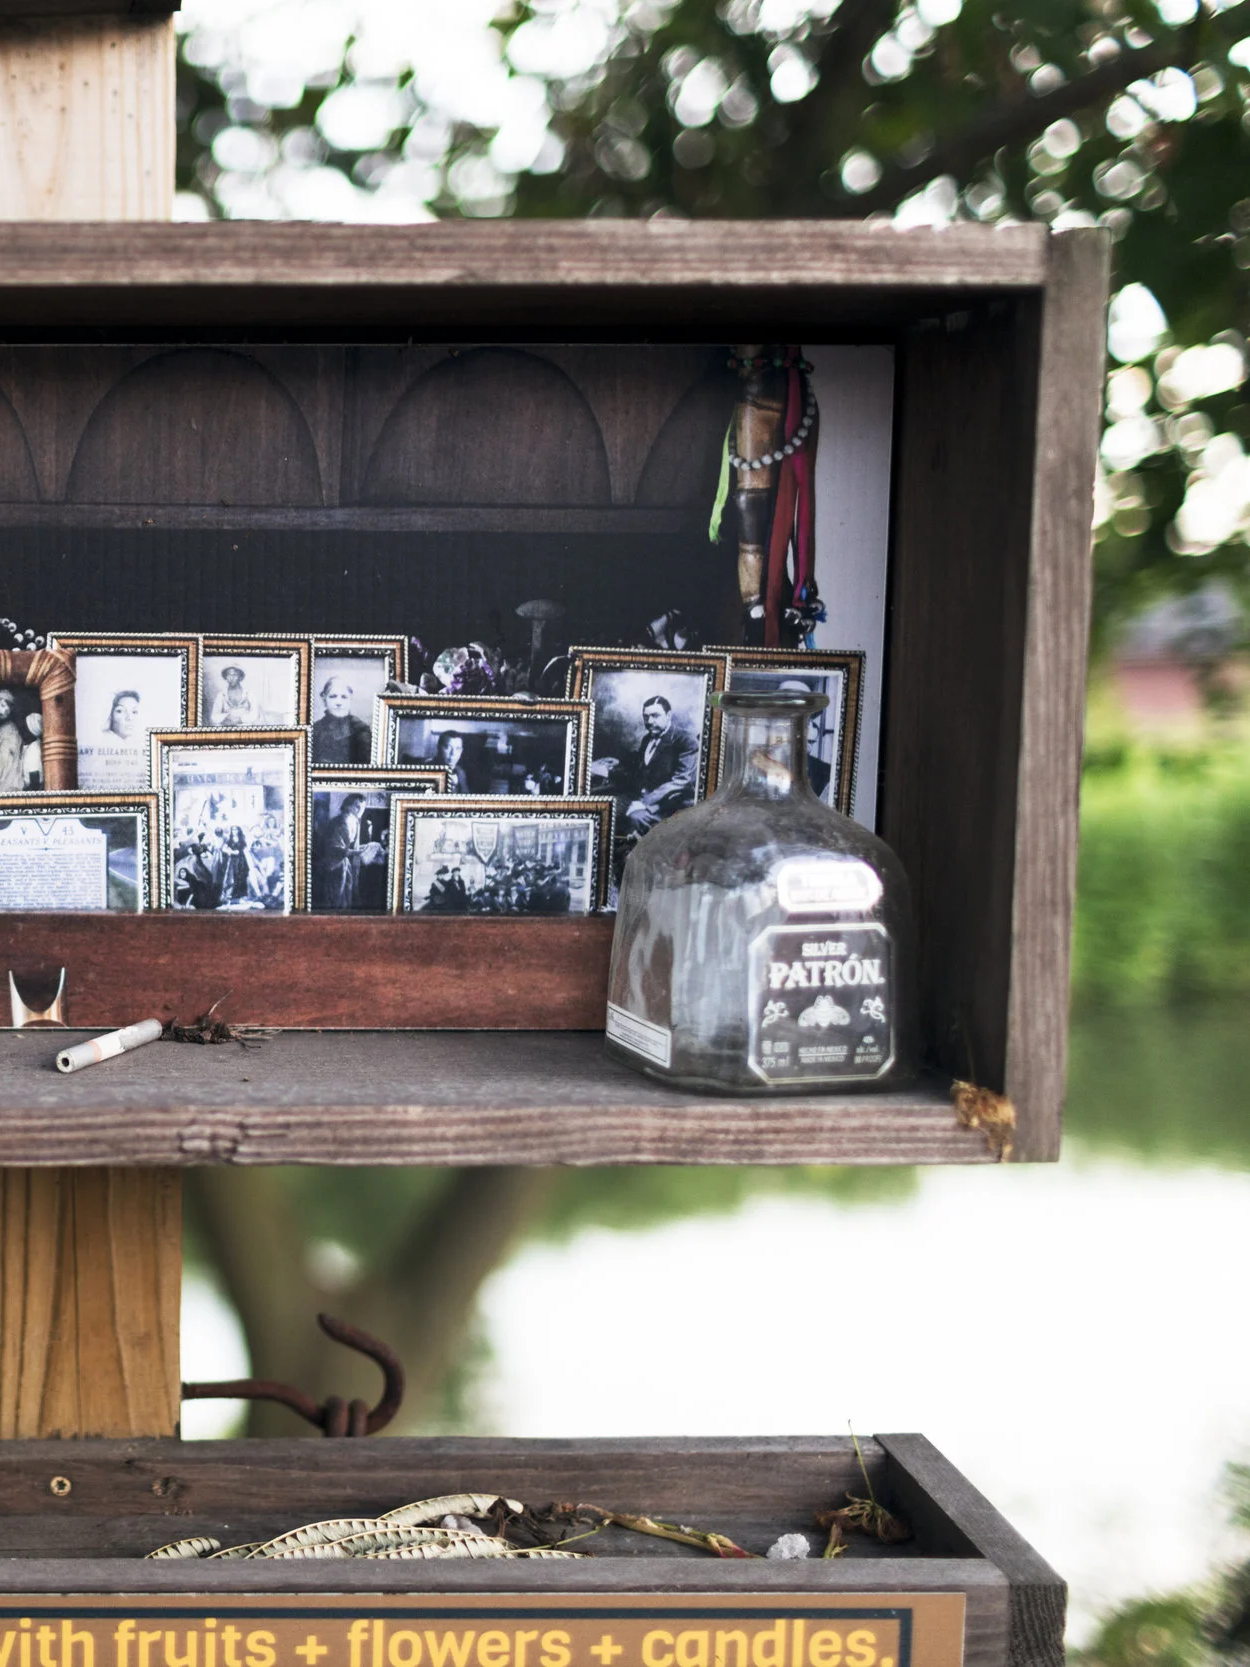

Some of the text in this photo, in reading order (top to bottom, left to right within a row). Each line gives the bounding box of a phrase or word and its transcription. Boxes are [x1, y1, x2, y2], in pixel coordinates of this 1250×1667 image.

[52, 836, 103, 846] PLEASANTS
[801, 940, 847, 956] SILVER
[114, 1617, 277, 1667] fruits
[295, 1635, 328, 1666] +
[347, 1619, 572, 1667] flowers
[590, 1634, 623, 1666] +
